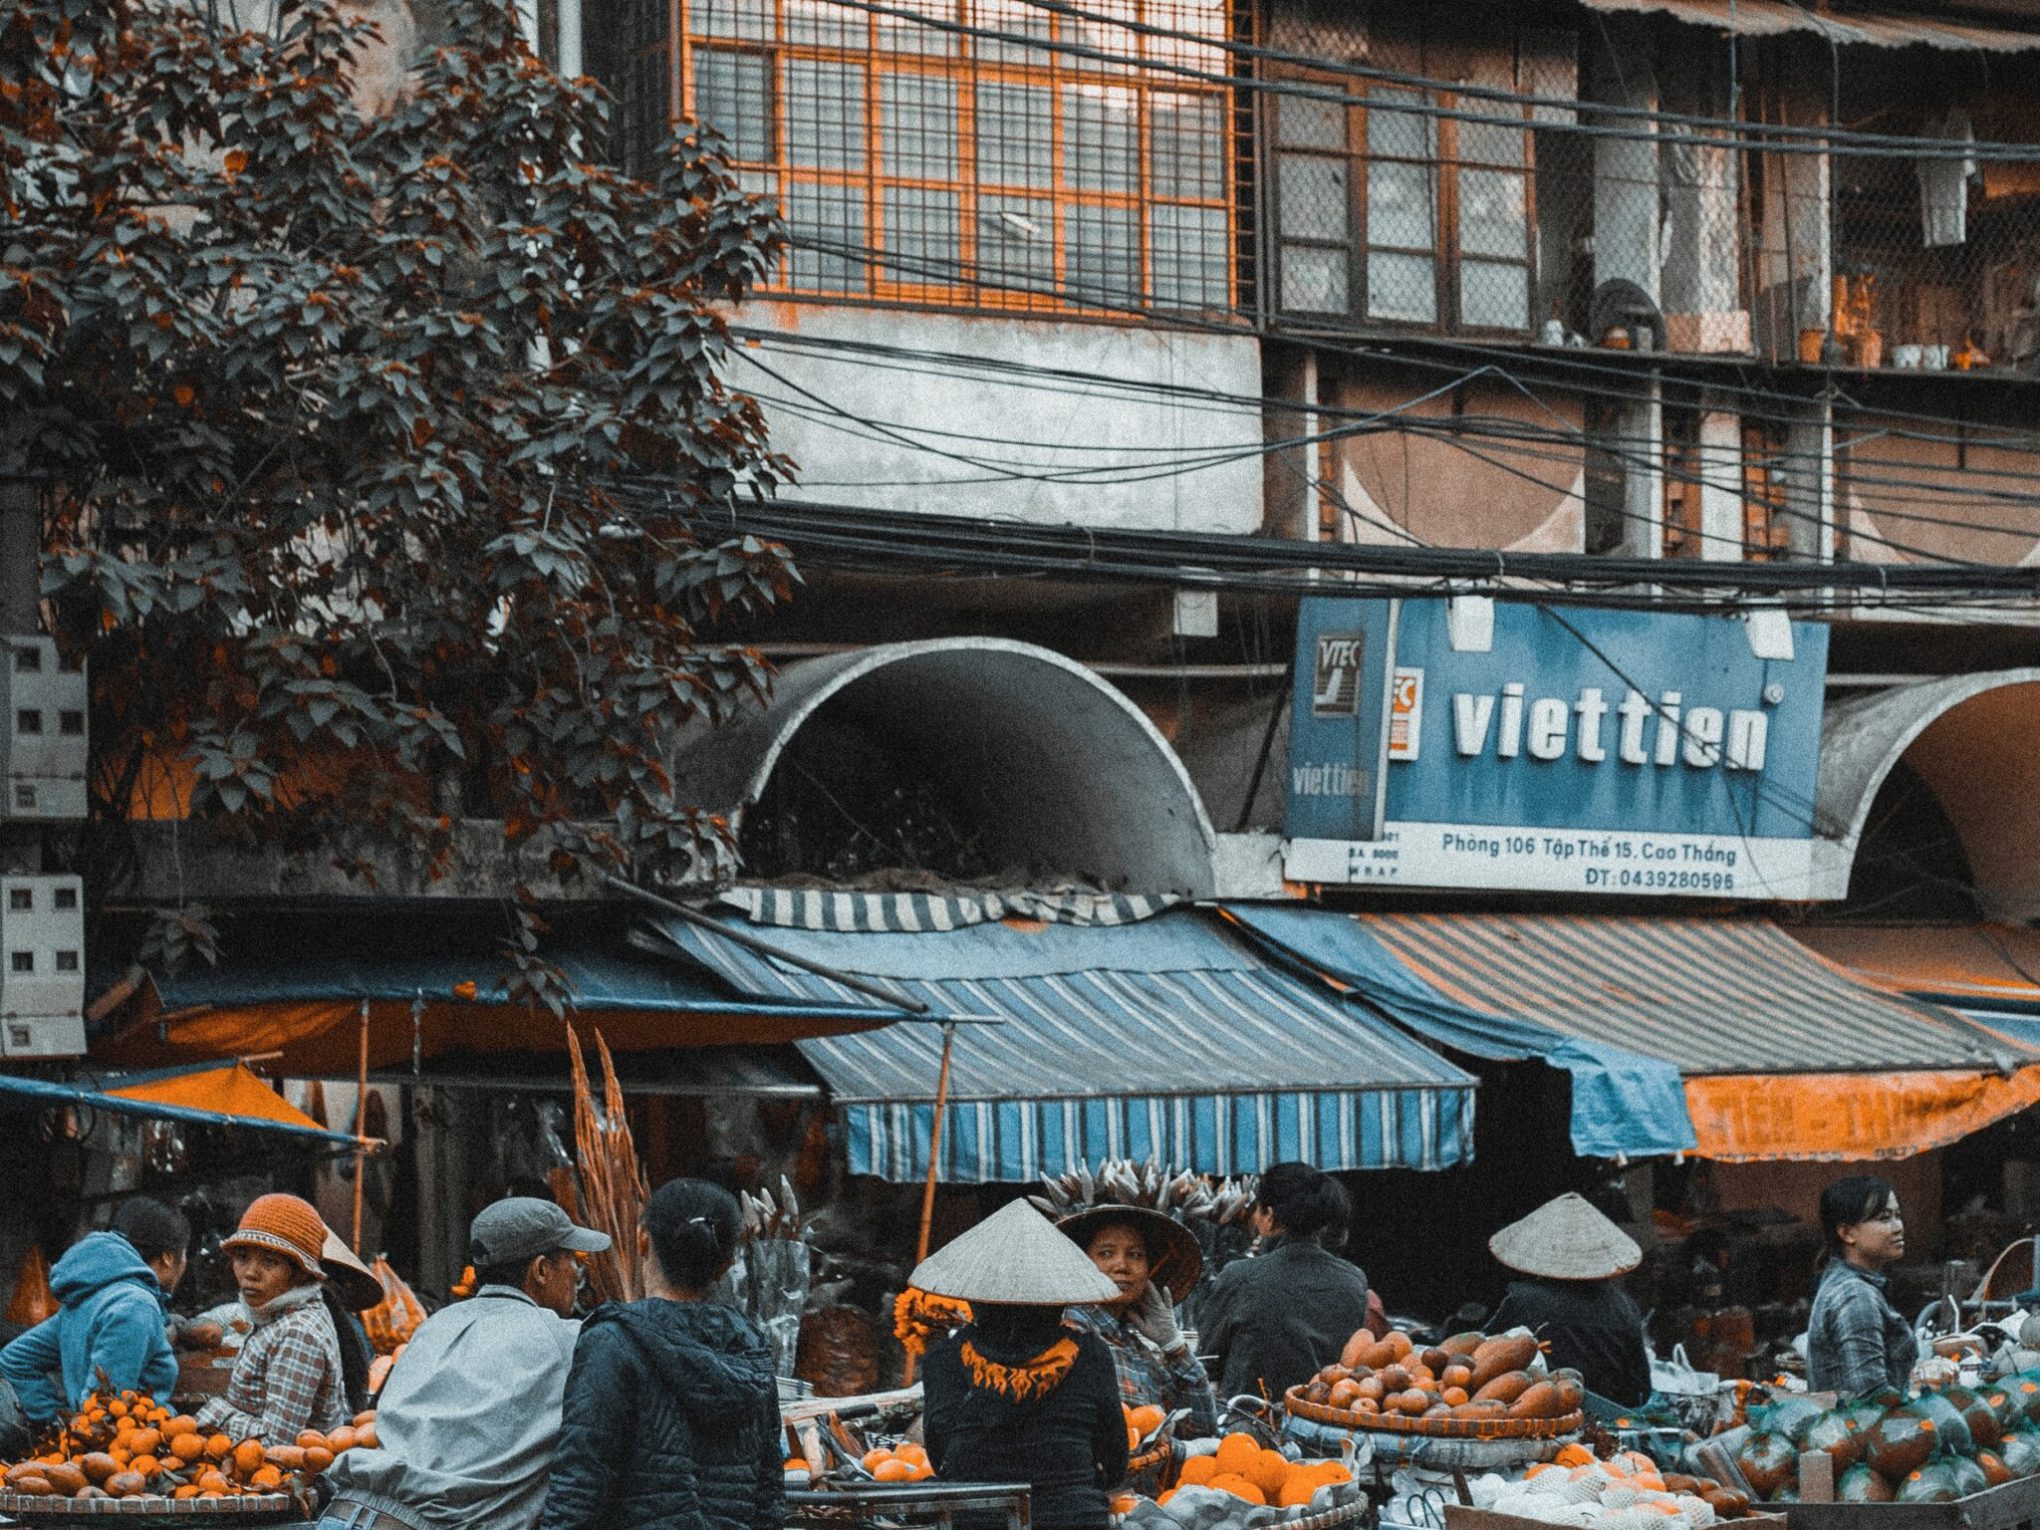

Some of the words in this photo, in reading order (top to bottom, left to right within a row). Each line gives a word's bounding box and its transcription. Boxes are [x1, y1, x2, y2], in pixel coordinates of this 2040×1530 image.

[1453, 681, 1769, 771] viettien
[1292, 760, 1370, 796] viettien
[1506, 836, 1536, 855] 106
[1642, 842, 1677, 860] Cao
